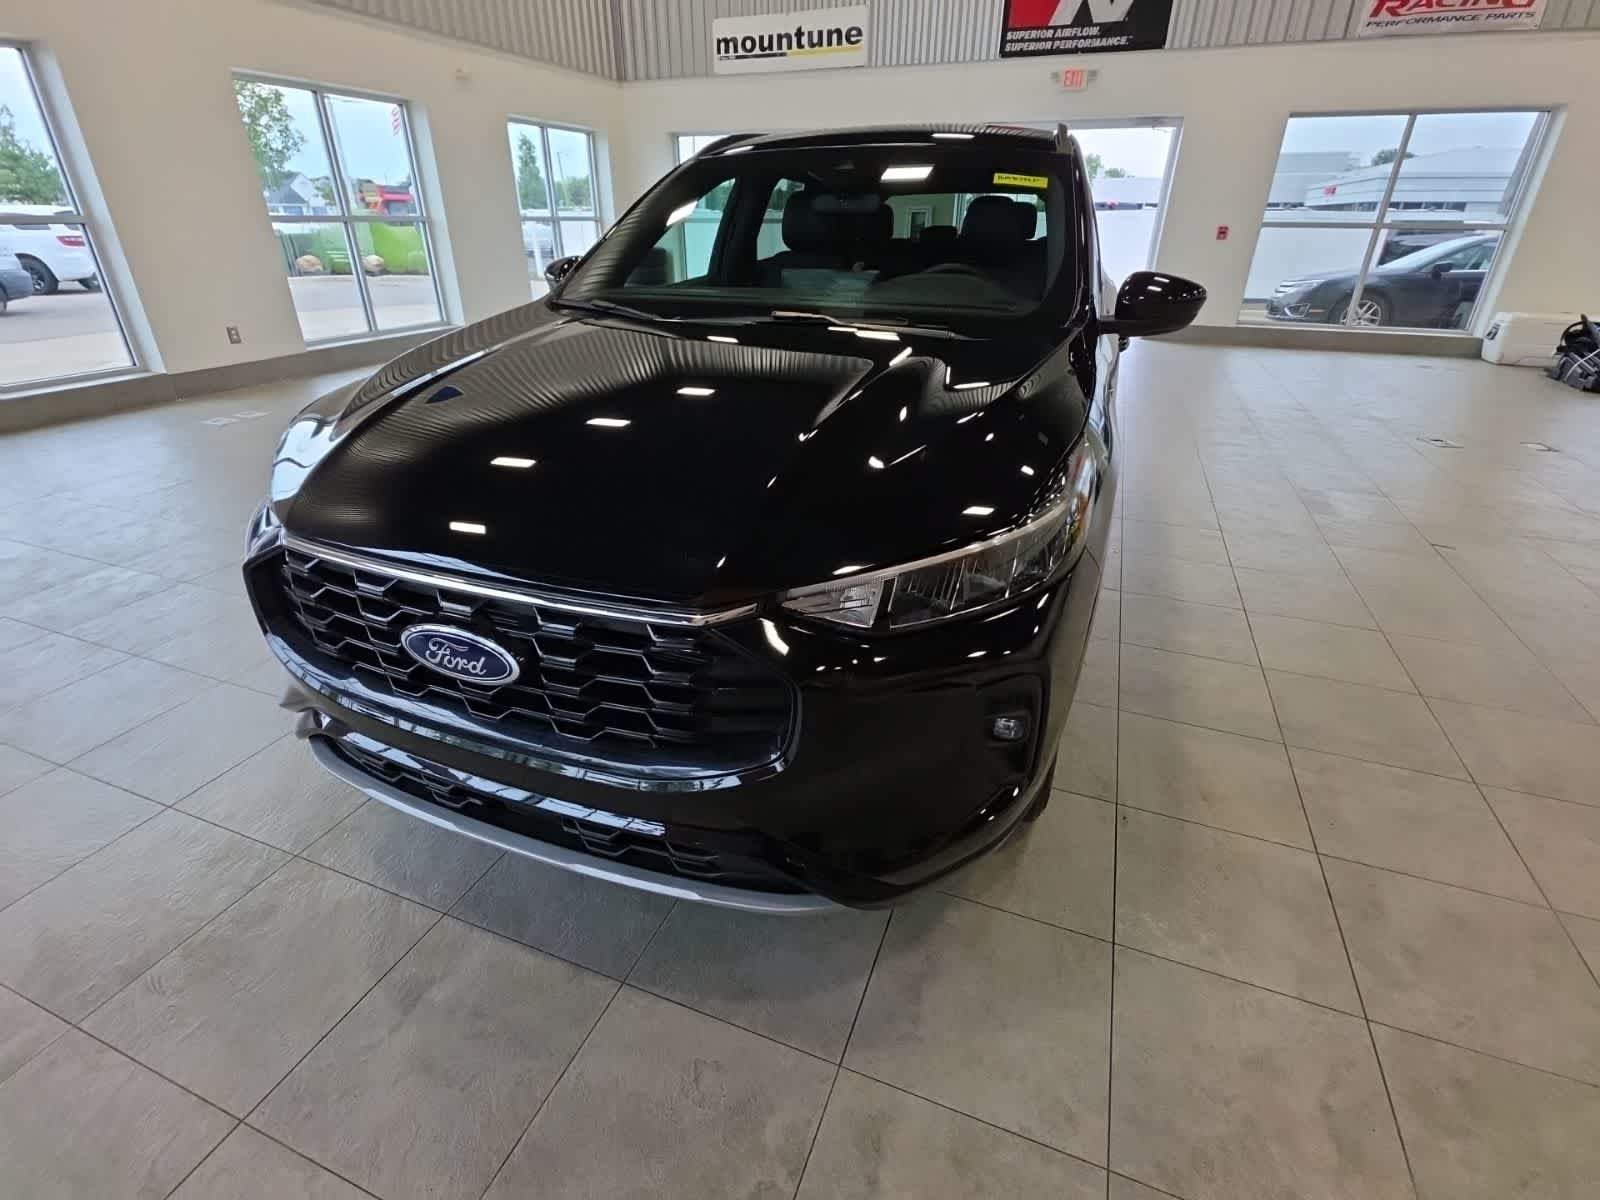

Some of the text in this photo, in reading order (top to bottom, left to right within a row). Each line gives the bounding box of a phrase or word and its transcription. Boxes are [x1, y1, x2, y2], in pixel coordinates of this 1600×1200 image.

[1366, 11, 1537, 27] PERFORMANCE PARTS
[716, 25, 863, 55] mountune
[1006, 28, 1053, 40] SUPERIOR
[1005, 39, 1052, 51] SUPERIOR
[425, 637, 487, 676] Ford
